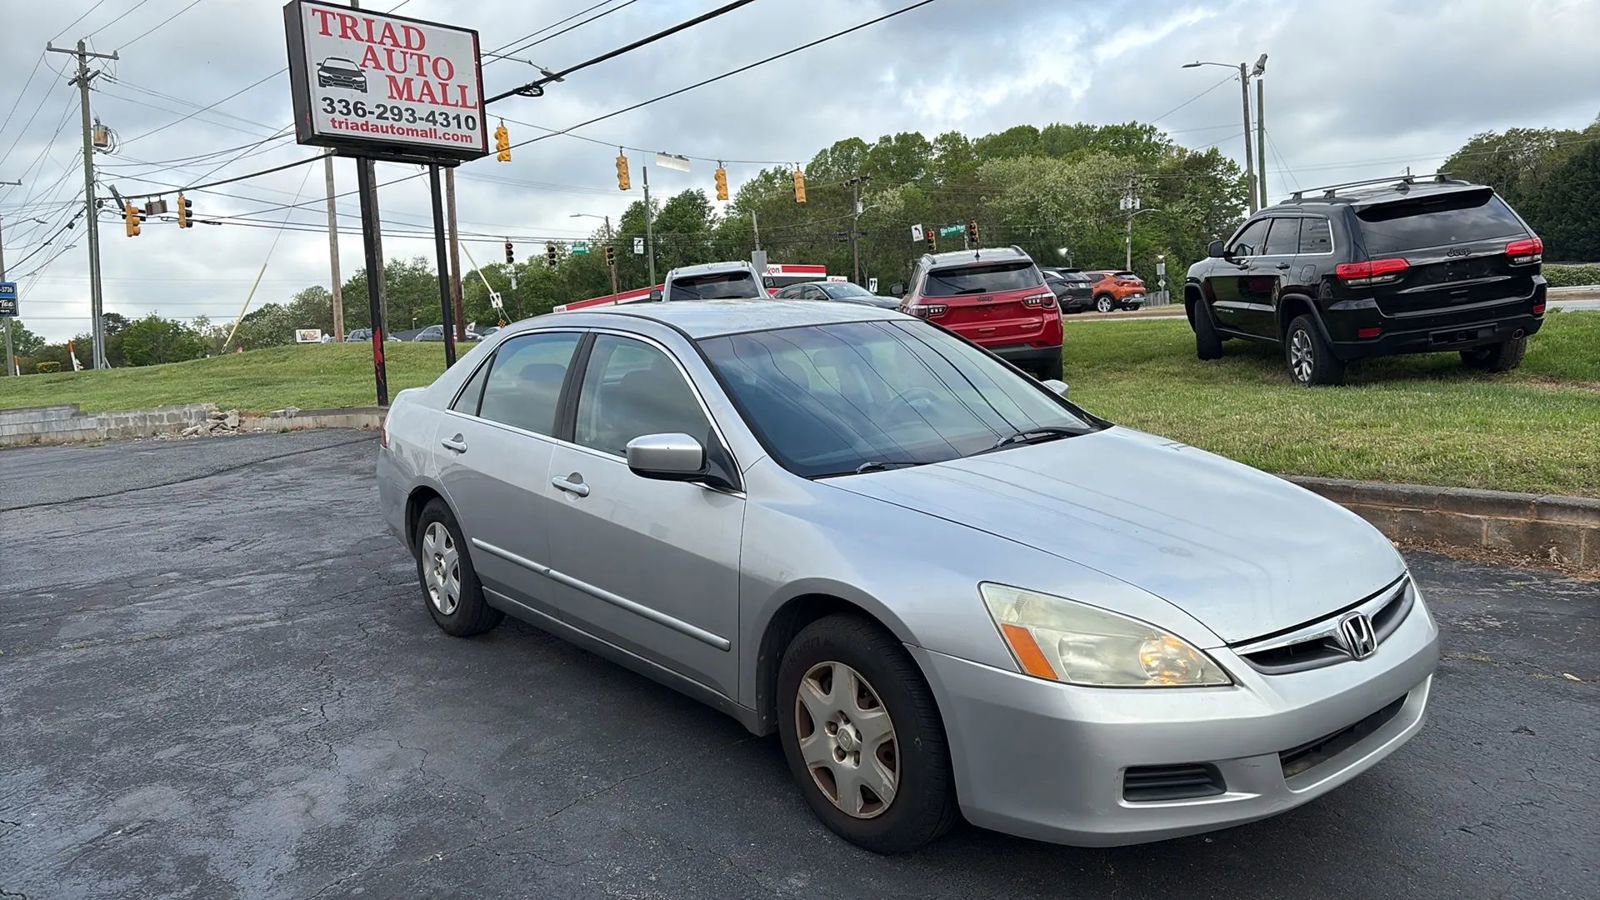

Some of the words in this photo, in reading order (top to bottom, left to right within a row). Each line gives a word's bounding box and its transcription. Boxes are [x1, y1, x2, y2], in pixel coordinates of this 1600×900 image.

[311, 8, 426, 51] TRIAD
[359, 45, 455, 81] AUTO
[386, 75, 477, 109] MALL
[321, 97, 477, 131] 336-293-4310
[330, 118, 473, 143] triadautomall.com
[1447, 248, 1472, 257] Jeep
